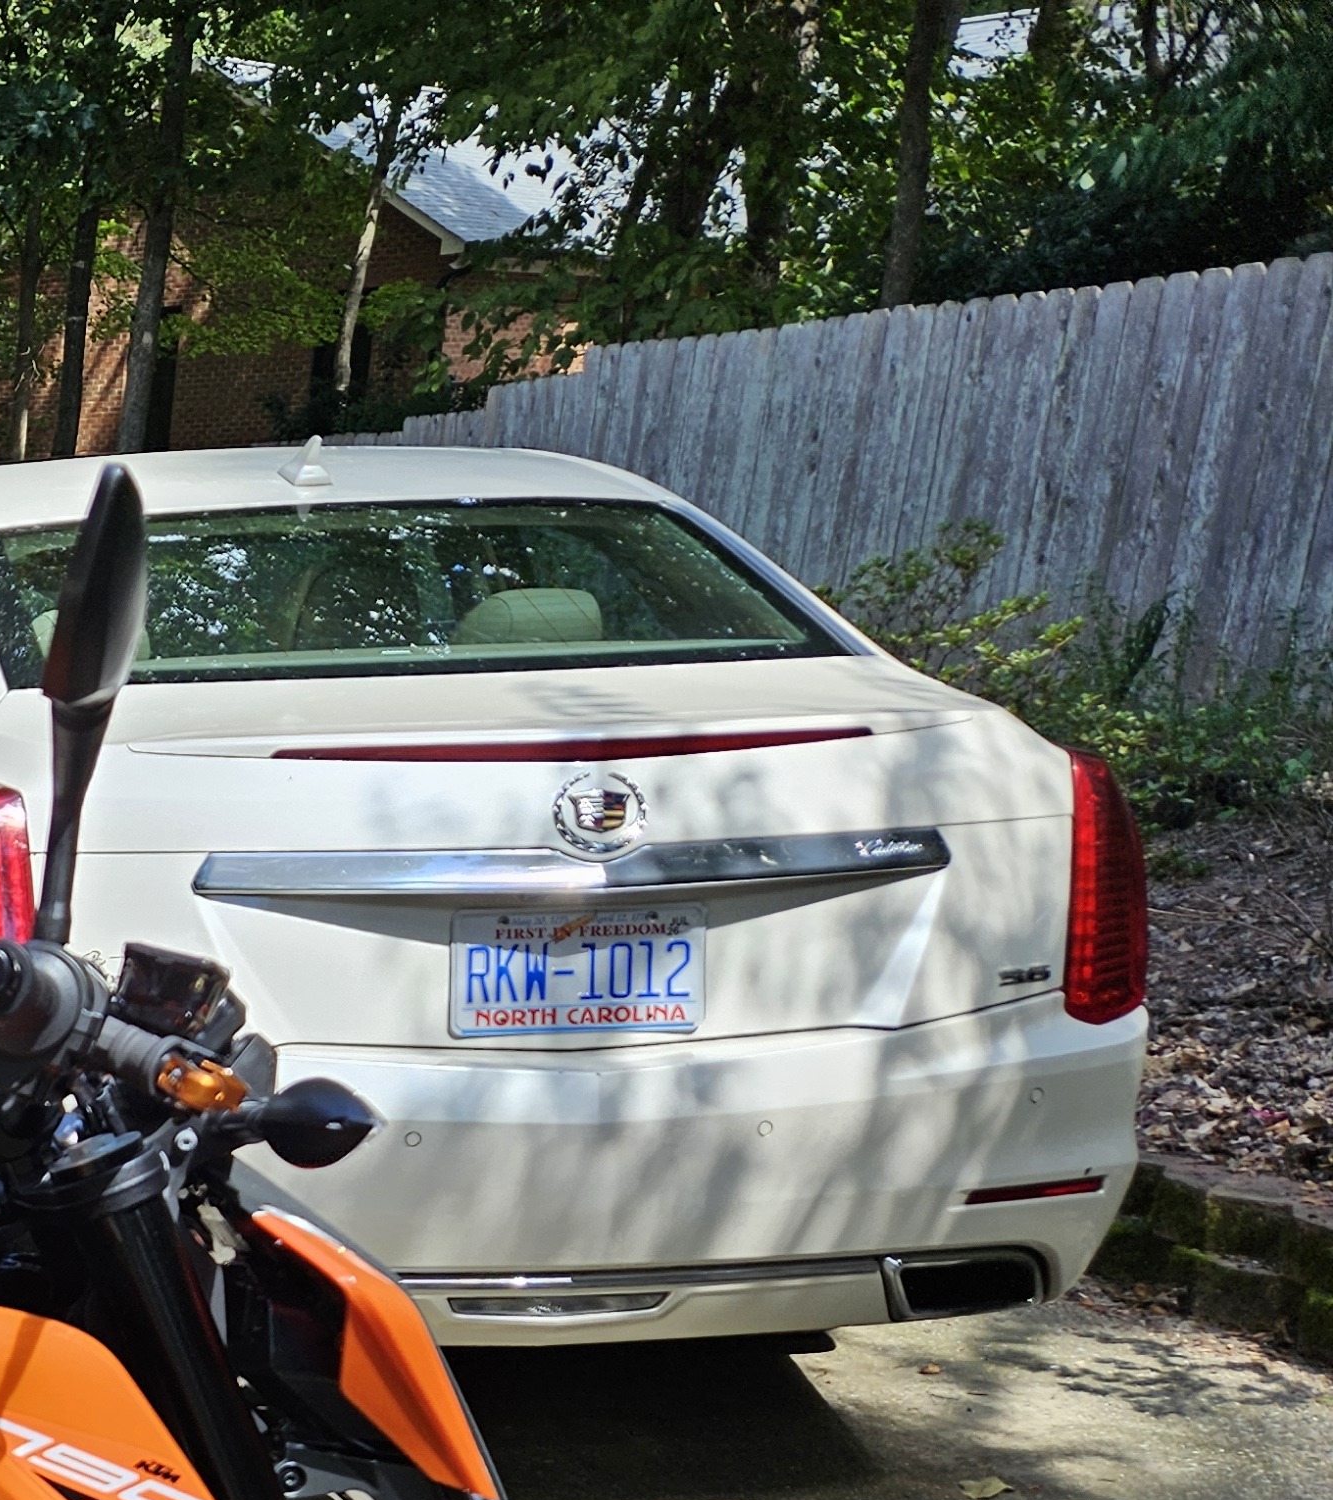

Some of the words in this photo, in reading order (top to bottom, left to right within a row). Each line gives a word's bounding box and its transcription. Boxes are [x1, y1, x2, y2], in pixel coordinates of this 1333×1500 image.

[495, 927, 547, 940] FIRST
[553, 926, 572, 940] IN
[580, 924, 667, 938] FREEDOM
[466, 941, 691, 1003] RKW-1012
[475, 1008, 557, 1026] NORTH
[567, 1004, 686, 1023] CAROLINA
[134, 1458, 181, 1484] KTM
